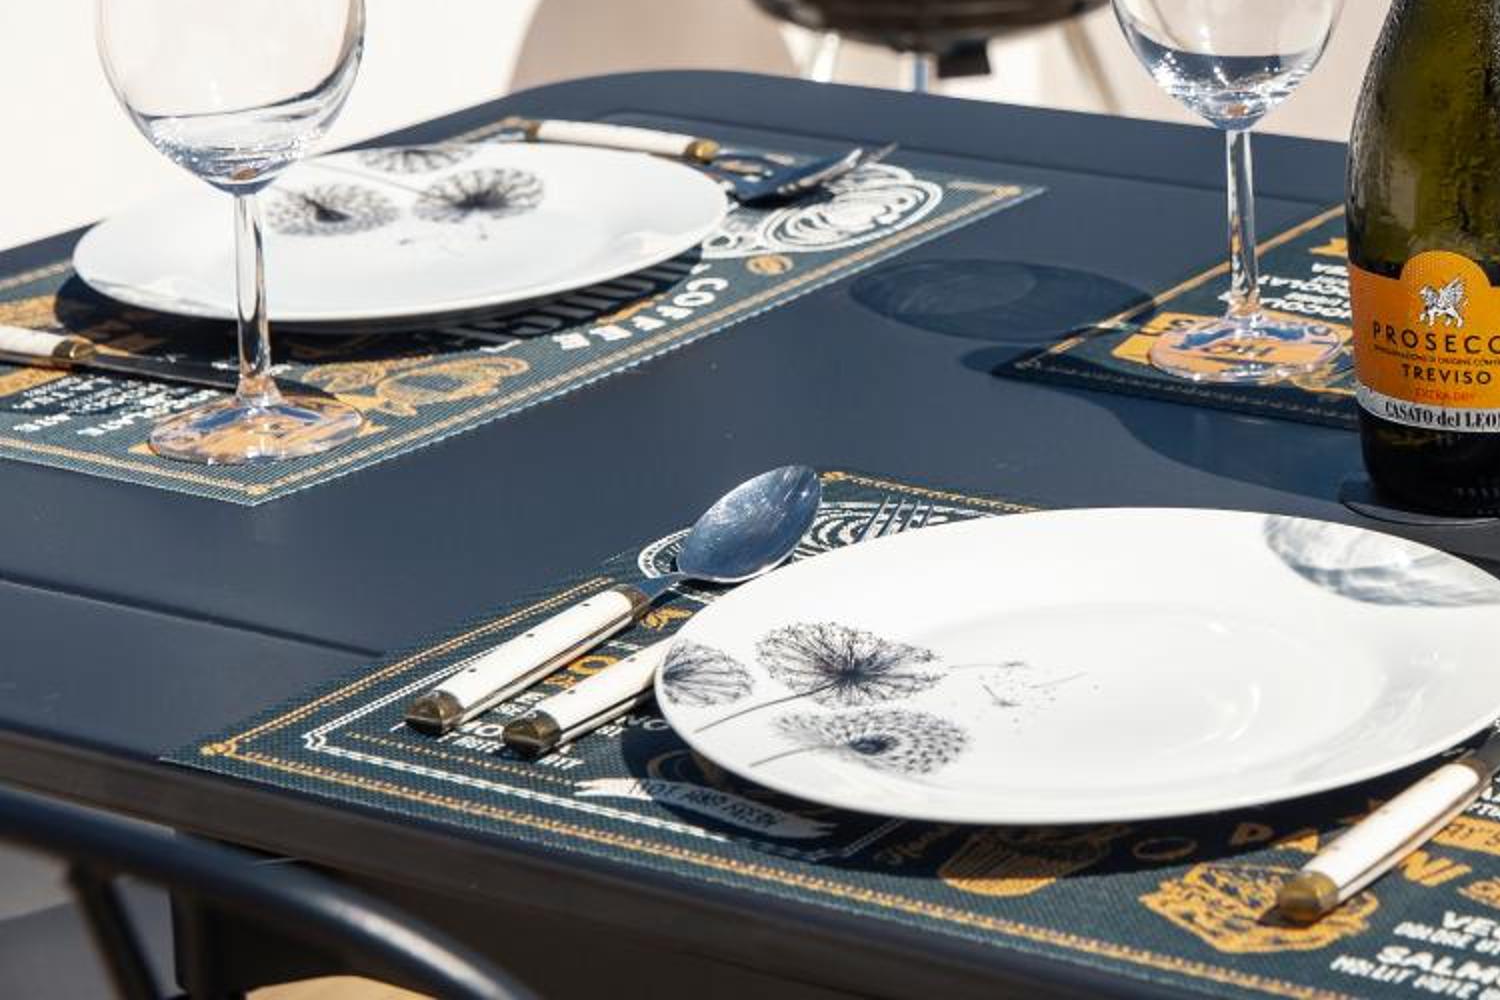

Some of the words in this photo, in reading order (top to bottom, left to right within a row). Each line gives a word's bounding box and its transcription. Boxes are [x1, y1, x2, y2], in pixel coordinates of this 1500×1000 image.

[1402, 363, 1491, 385] TREVISO
[1385, 401, 1433, 424] CASATO
[1437, 410, 1460, 427] del
